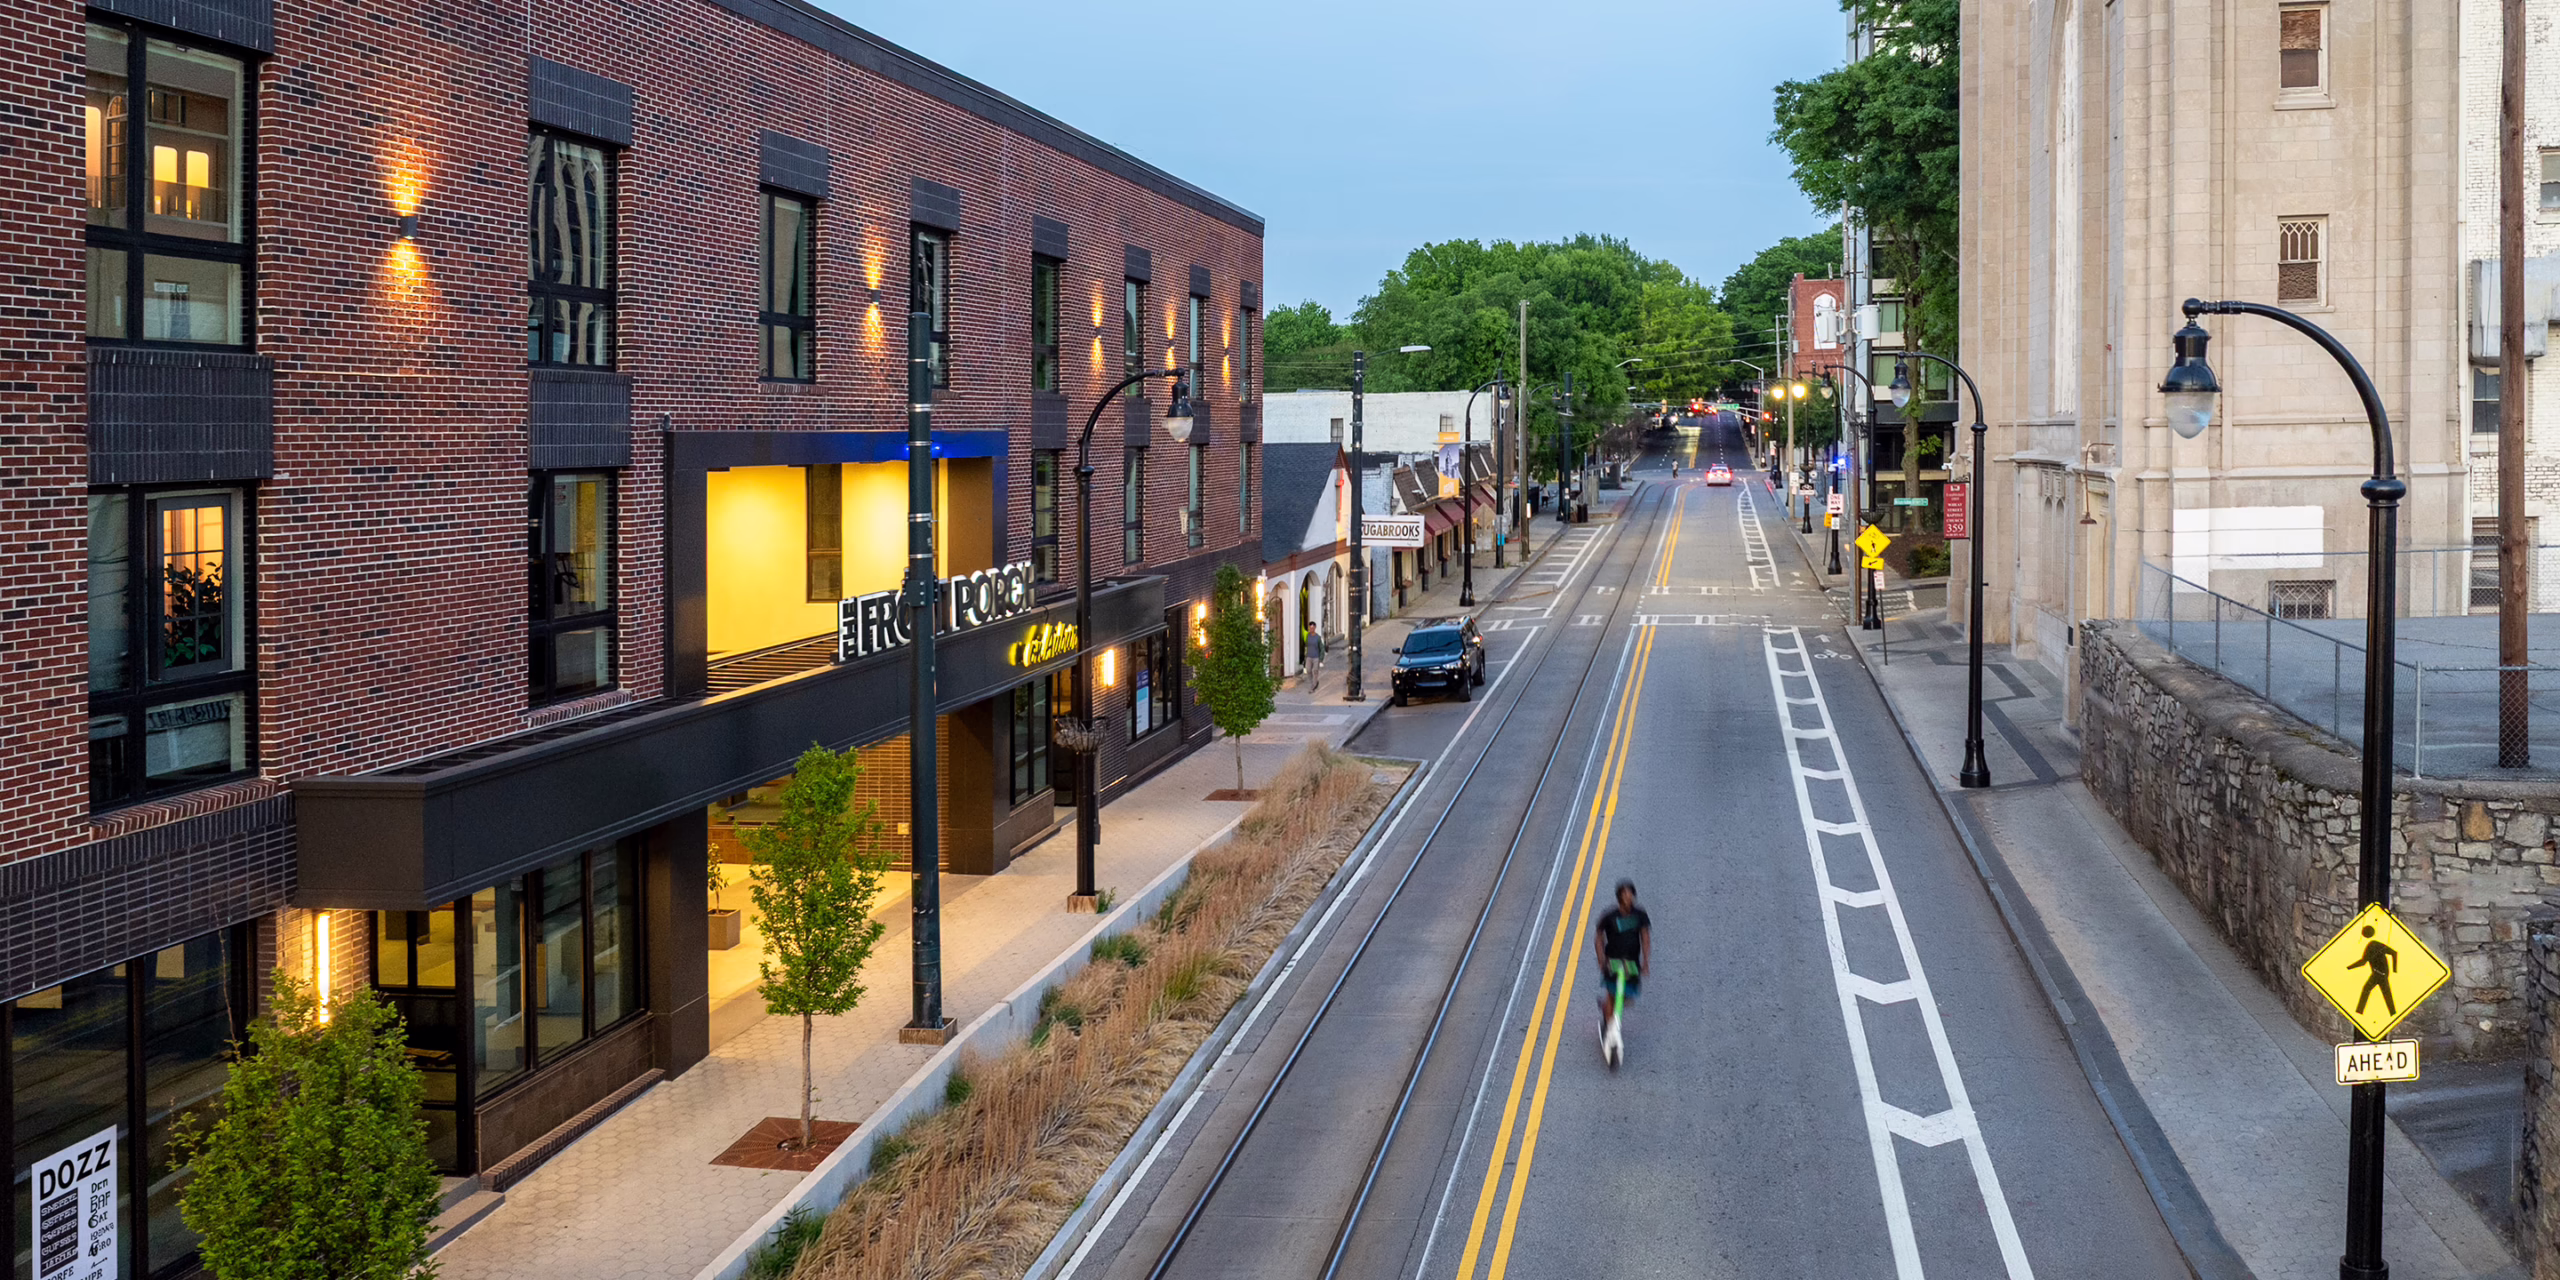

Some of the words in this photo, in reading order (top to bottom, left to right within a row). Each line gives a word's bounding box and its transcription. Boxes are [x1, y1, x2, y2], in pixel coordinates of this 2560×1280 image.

[1946, 523, 1964, 533] 359
[839, 596, 858, 662] THE
[951, 561, 1036, 631] PORCH
[40, 1139, 111, 1201] DOZZ
